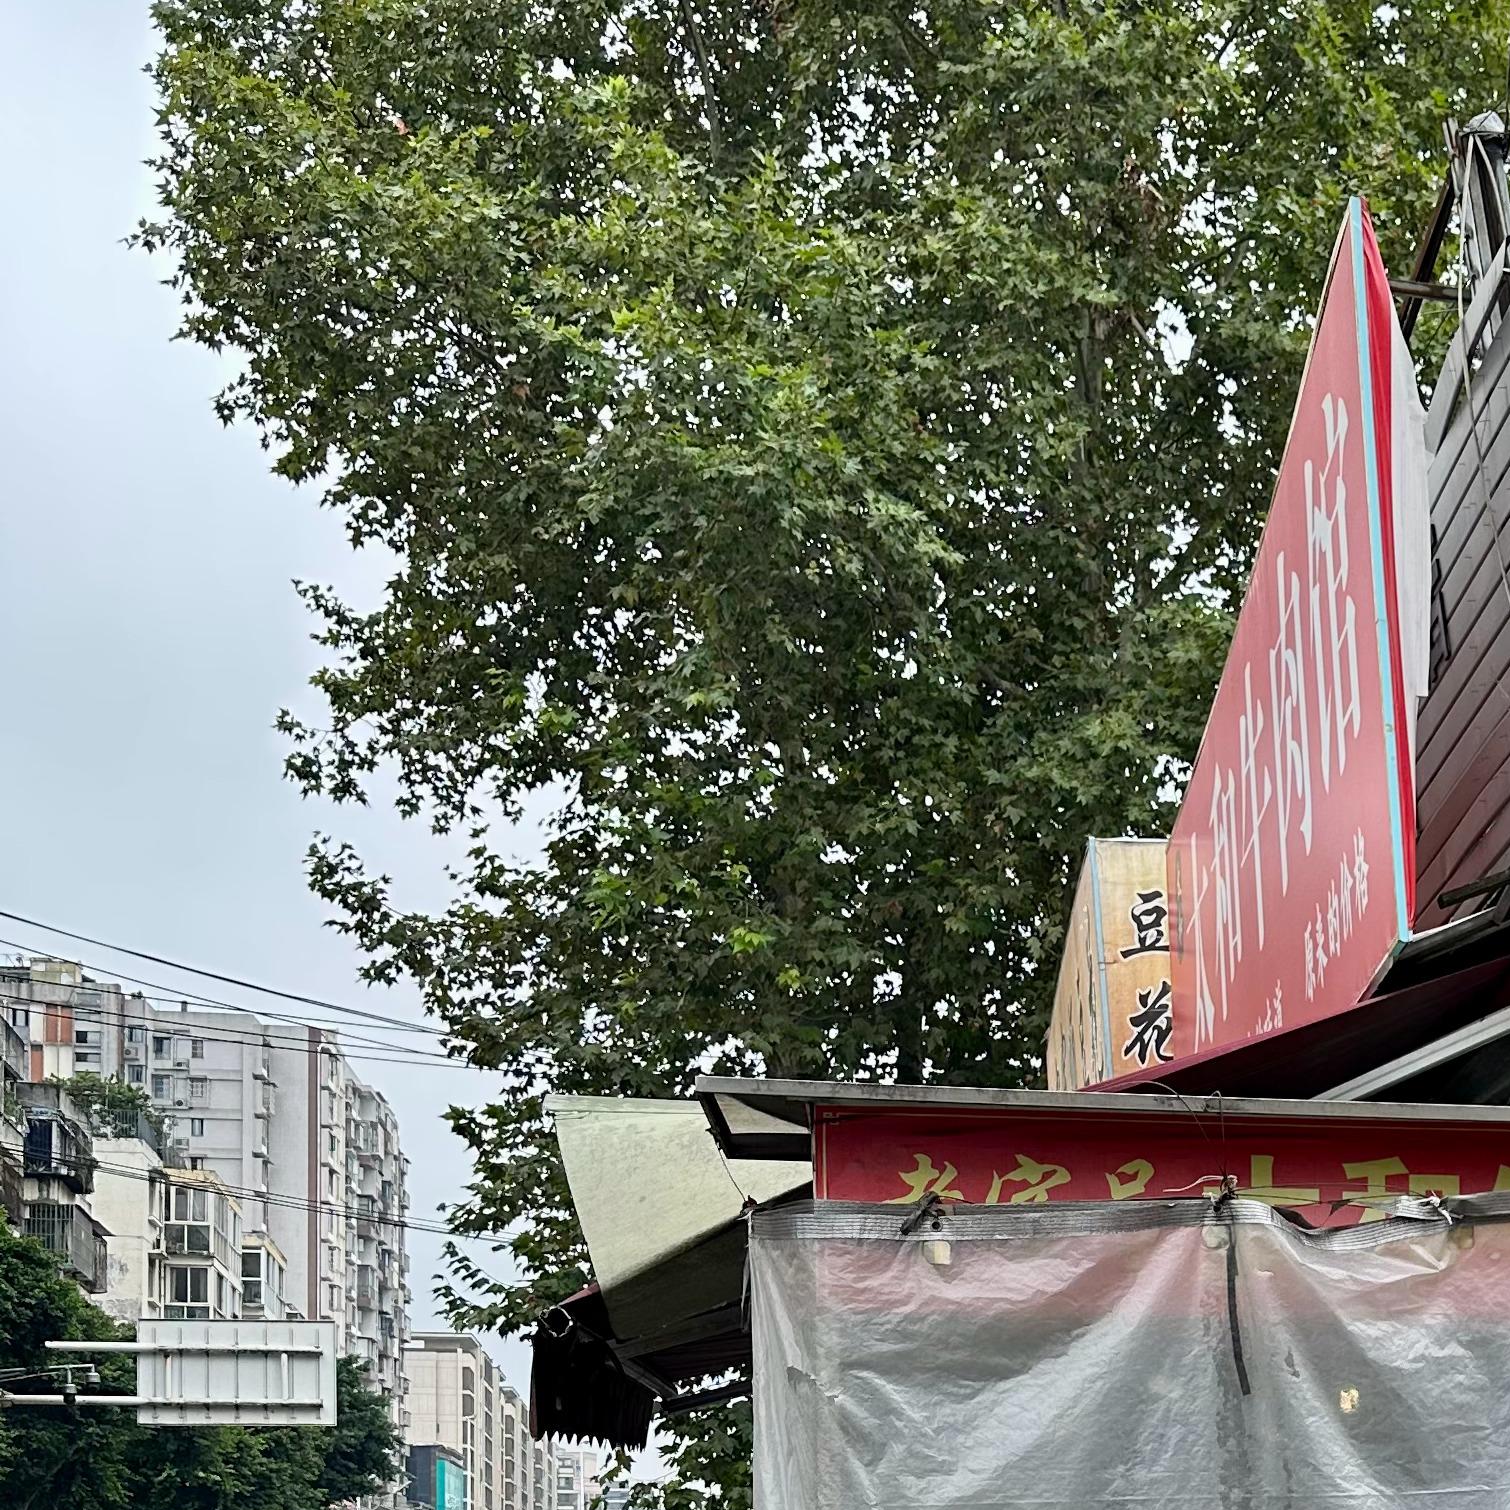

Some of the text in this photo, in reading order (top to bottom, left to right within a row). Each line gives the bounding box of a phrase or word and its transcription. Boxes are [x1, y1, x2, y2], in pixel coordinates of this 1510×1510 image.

[1186, 392, 1361, 1054] 太和牛肉馆
[1120, 889, 1174, 1065] 豆花
[1304, 827, 1369, 1003] 原来的价格
